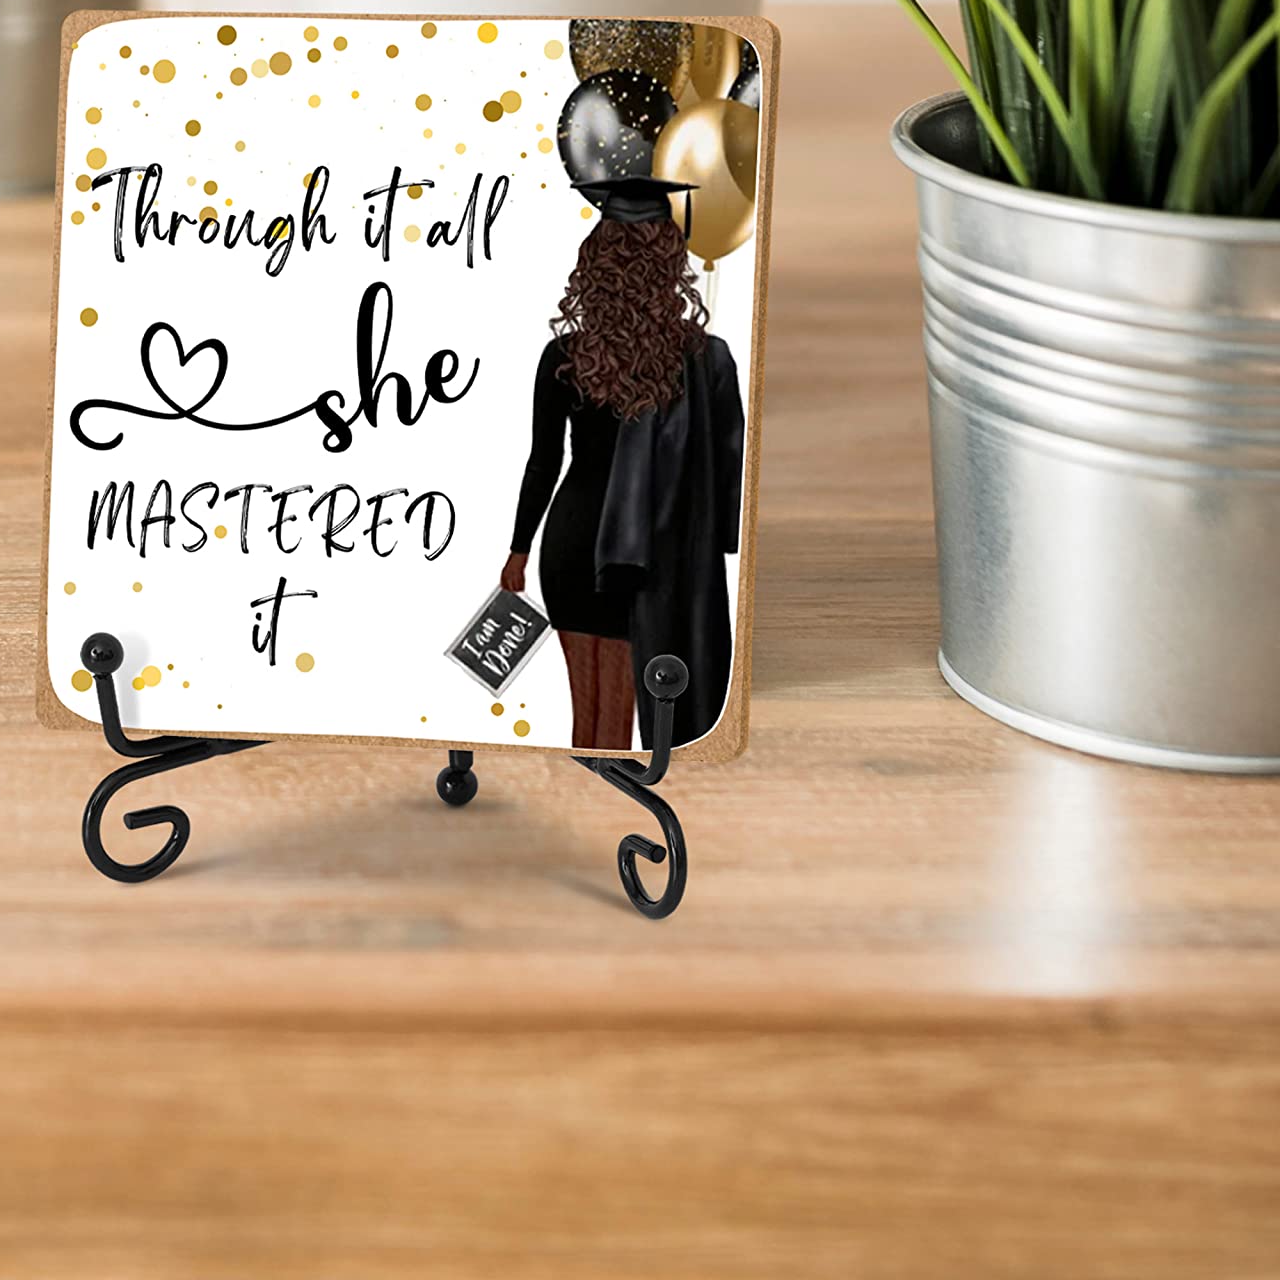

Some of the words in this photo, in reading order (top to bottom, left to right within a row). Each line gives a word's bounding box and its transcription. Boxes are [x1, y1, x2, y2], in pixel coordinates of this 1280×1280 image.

[92, 164, 336, 277] Through
[364, 167, 435, 263] it
[426, 172, 510, 269] all
[316, 281, 480, 453] she
[87, 479, 456, 562] MASTERED
[251, 577, 318, 666] it
[461, 639, 482, 659] I
[475, 618, 501, 646] am
[482, 612, 542, 677] Done!
